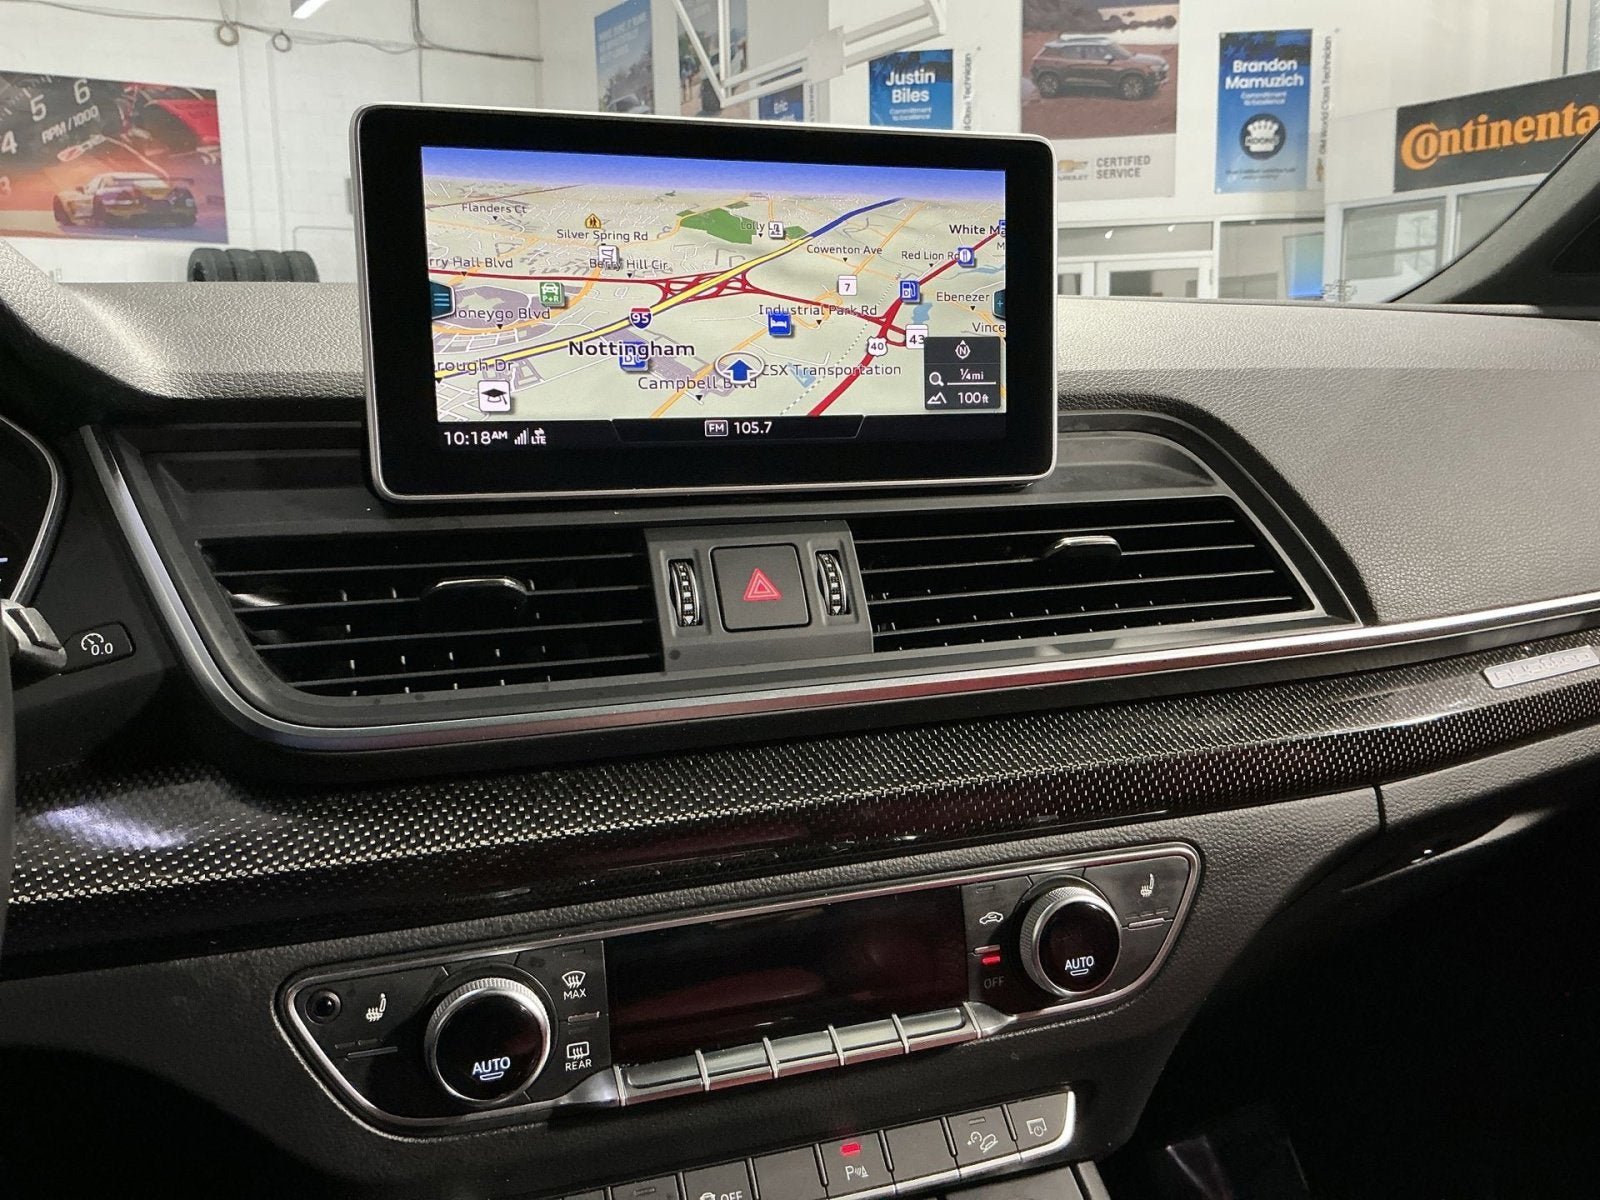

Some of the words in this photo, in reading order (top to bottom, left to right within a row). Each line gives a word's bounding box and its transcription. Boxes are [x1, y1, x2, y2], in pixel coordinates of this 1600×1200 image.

[1233, 57, 1298, 73] Brandon
[1321, 36, 1332, 84] Technician
[885, 68, 936, 86] Justin
[1225, 73, 1304, 90] Mamuzich
[74, 79, 91, 104] 6
[892, 88, 930, 103] Biles
[30, 94, 47, 122] 5
[1, 130, 18, 154] 4
[1096, 155, 1151, 168] CERTIFIED
[1096, 168, 1141, 180] SERVICE
[462, 203, 511, 213] Flanders
[515, 204, 527, 213] Ct
[741, 221, 765, 232] Lolly
[949, 224, 985, 235] White
[556, 229, 589, 239] Silver
[593, 231, 630, 243] Spring
[634, 231, 649, 241] Rd
[806, 244, 862, 254] Cowenton
[863, 246, 883, 255] Ave
[901, 251, 920, 259] Red
[923, 251, 944, 260] Lion
[453, 256, 482, 267] Hall
[485, 257, 513, 268] Blvd
[626, 260, 648, 269] Hill
[651, 260, 668, 270] Cir
[844, 283, 851, 292] 7
[936, 292, 990, 302] Ebenezer
[518, 308, 551, 320] Blvd
[759, 304, 824, 315] Industrial
[829, 305, 857, 315] Park
[861, 305, 877, 315] Rd
[632, 313, 650, 323] 95
[972, 322, 1006, 333] Vince
[568, 341, 695, 360] Nottingham
[495, 359, 514, 371] Dr
[793, 364, 901, 379] Transportation
[638, 377, 716, 392] Campbell
[708, 424, 725, 433] FM
[734, 421, 772, 434] 105.7
[531, 436, 547, 445] LTE
[1064, 956, 1094, 971] AUTO
[984, 976, 1004, 990] OFF
[563, 988, 587, 1000] MAX
[472, 1056, 511, 1075] AUTO
[565, 1059, 592, 1072] REAR
